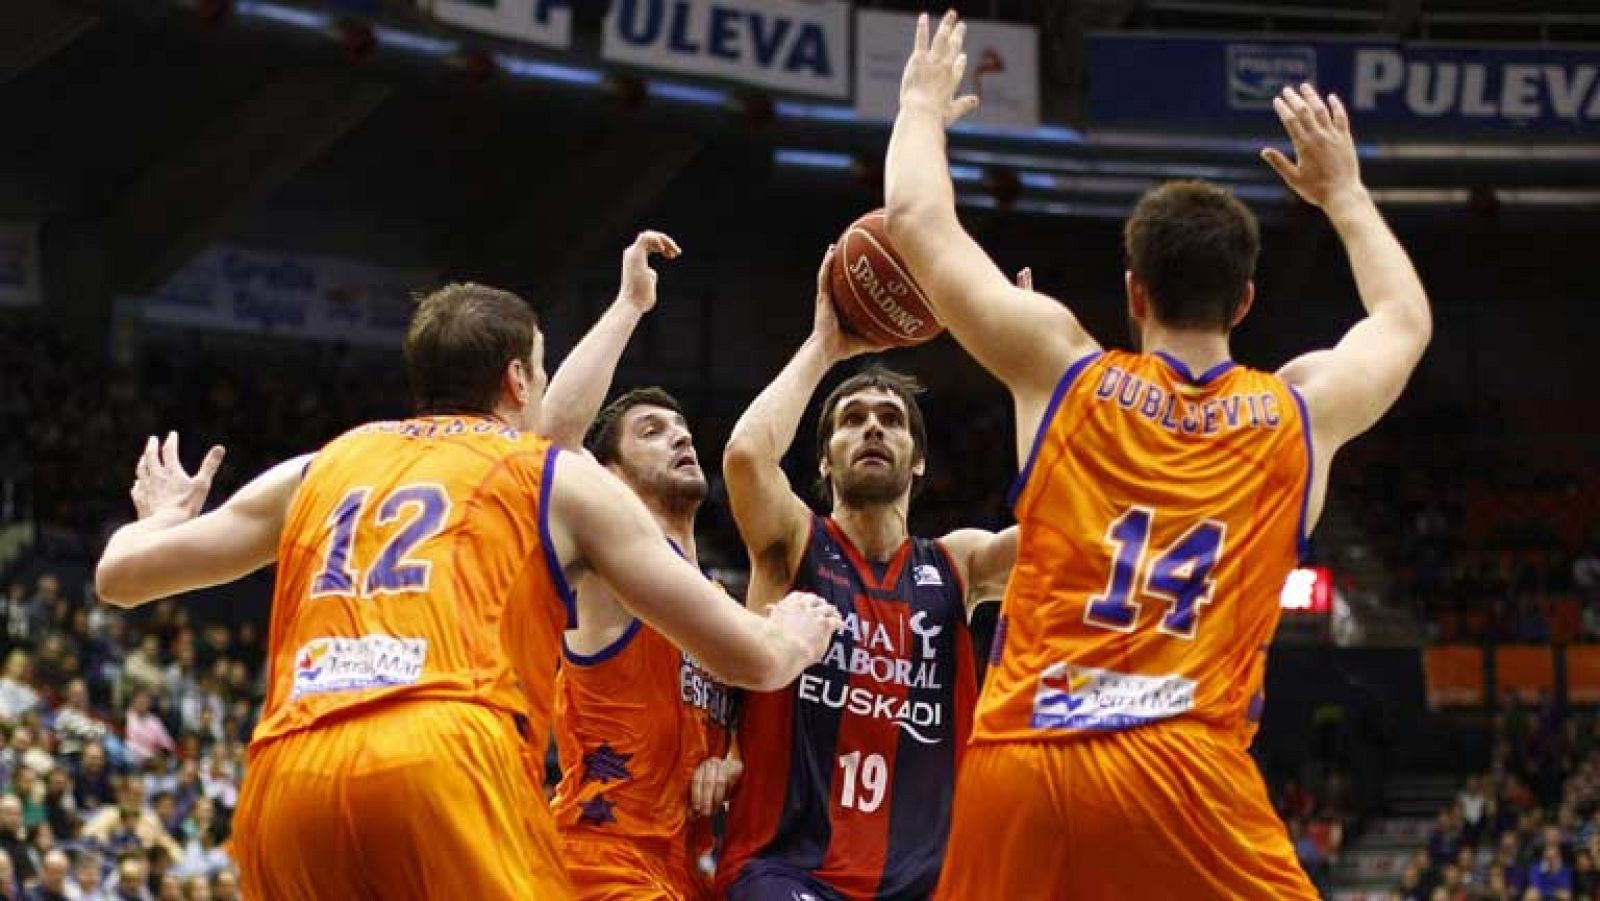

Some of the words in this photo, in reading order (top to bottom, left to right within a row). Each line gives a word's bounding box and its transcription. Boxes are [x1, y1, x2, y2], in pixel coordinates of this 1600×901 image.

[849, 253, 924, 338] SPALDING
[1095, 366, 1280, 436] DUBLJEVIC
[311, 484, 451, 600] 12
[1083, 504, 1226, 639] 14
[838, 612, 894, 652] AJA
[822, 640, 942, 690] ABORAL
[799, 672, 942, 727] EUSKADI
[839, 751, 888, 812] 19
